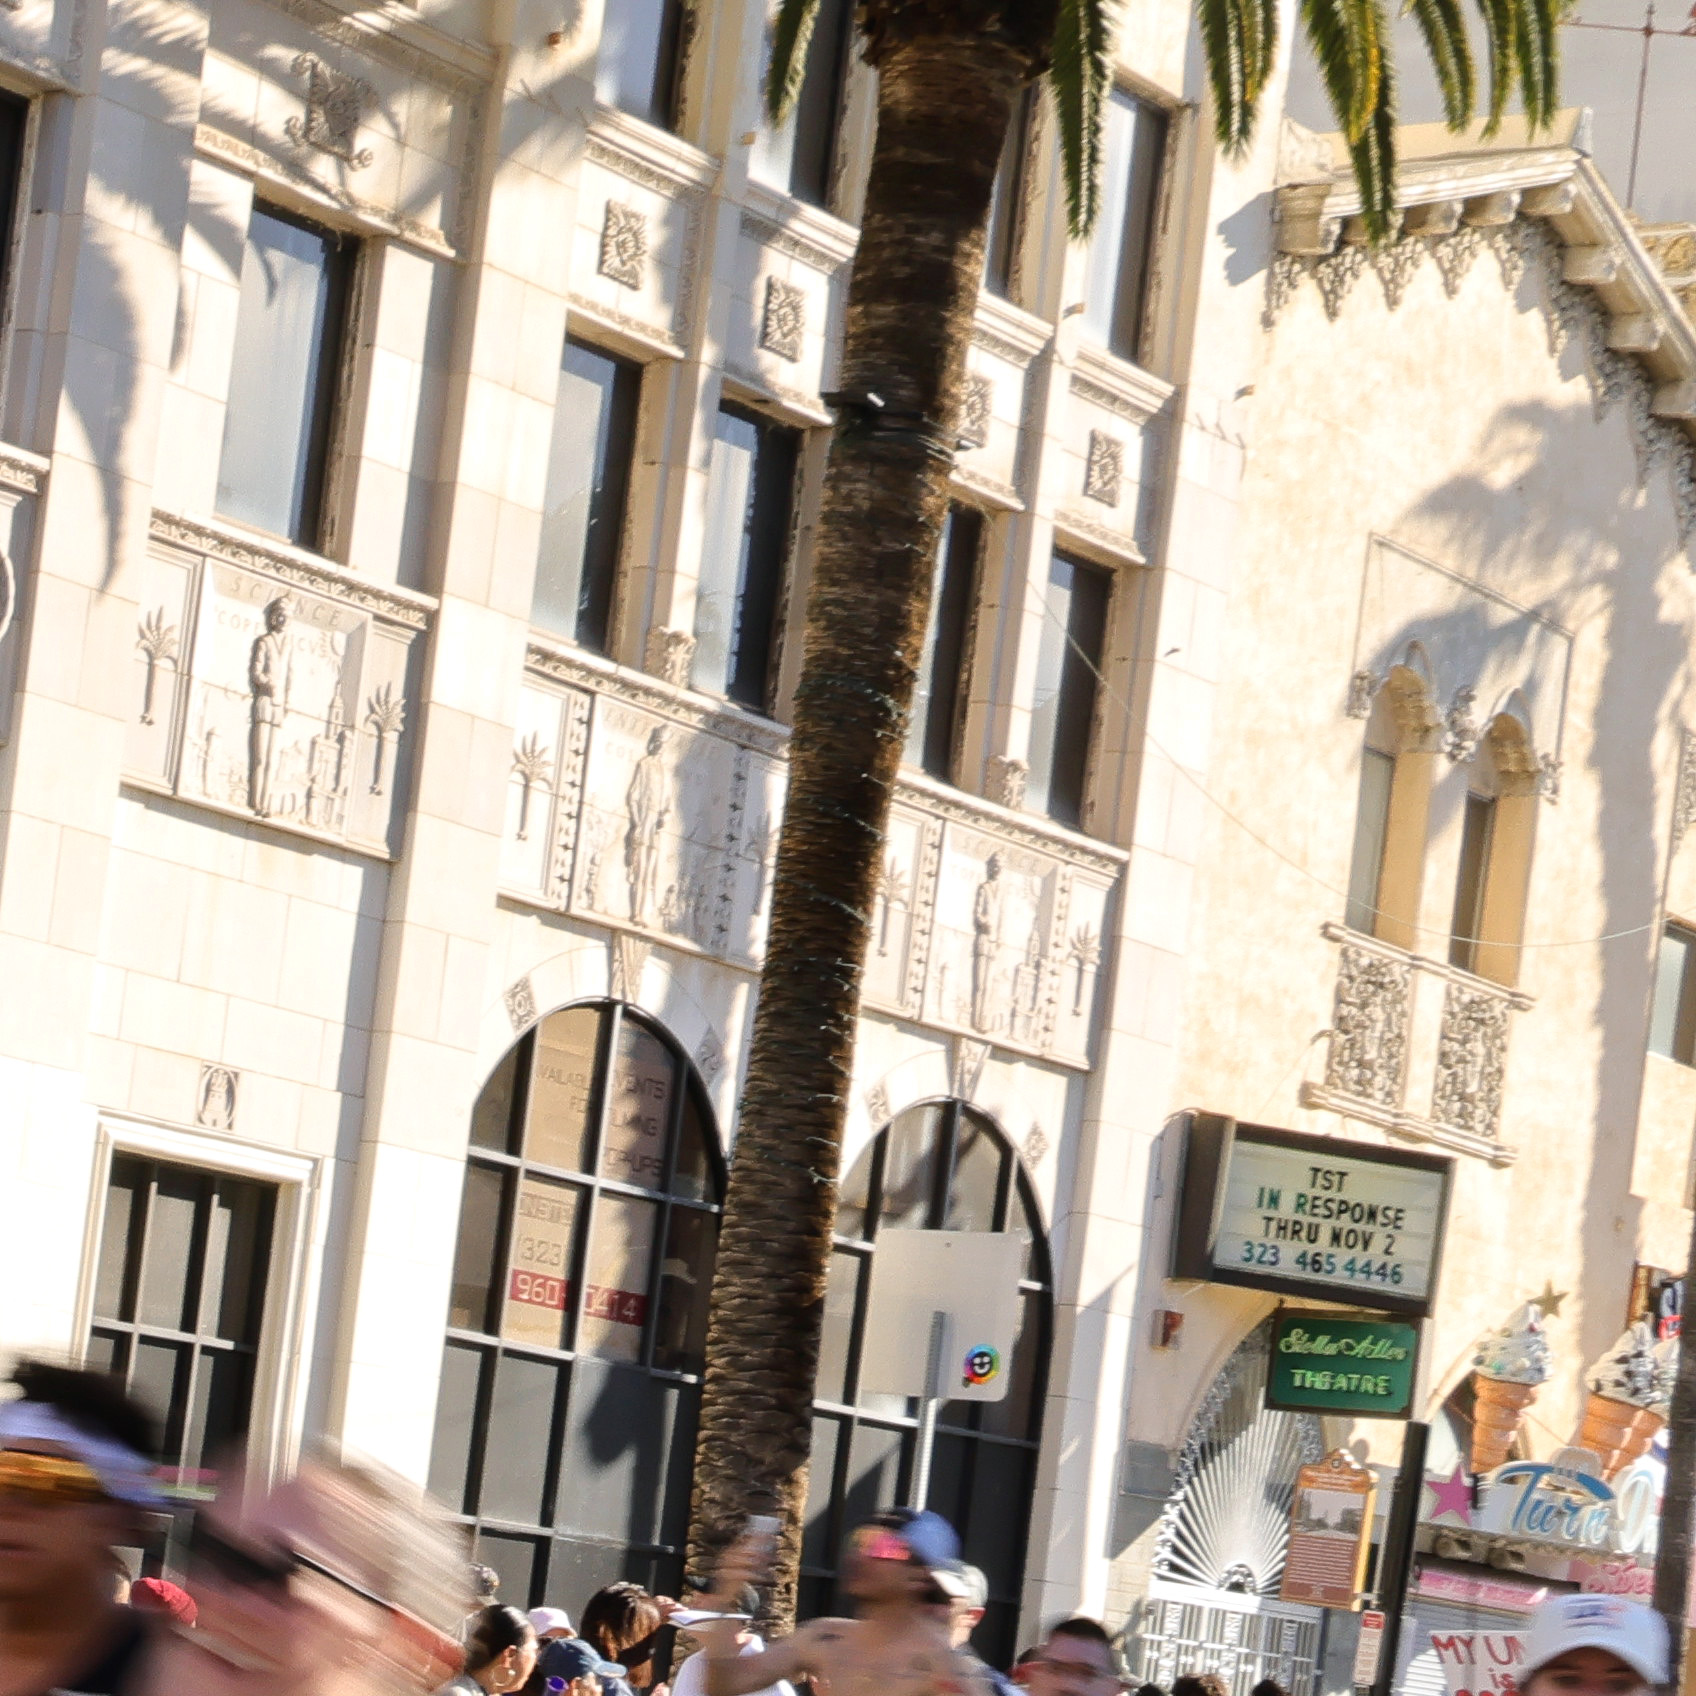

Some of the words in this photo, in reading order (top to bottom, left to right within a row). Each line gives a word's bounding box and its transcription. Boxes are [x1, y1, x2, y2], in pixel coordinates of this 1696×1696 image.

[230, 575, 342, 627] SCINCE
[1309, 1166, 1349, 1193] TST
[1256, 1186, 1282, 1211] IN
[1294, 1192, 1407, 1231] RESPONSE
[1262, 1215, 1321, 1245] THRU
[1329, 1226, 1375, 1252] NOV
[1383, 1233, 1396, 1256] 2
[1240, 1239, 1281, 1266] 323
[1295, 1250, 1337, 1275] 465
[1343, 1256, 1403, 1285] 4446
[1290, 1368, 1393, 1396] THEATRE
[1431, 1634, 1477, 1665] MY
[1488, 1667, 1516, 1690] is
